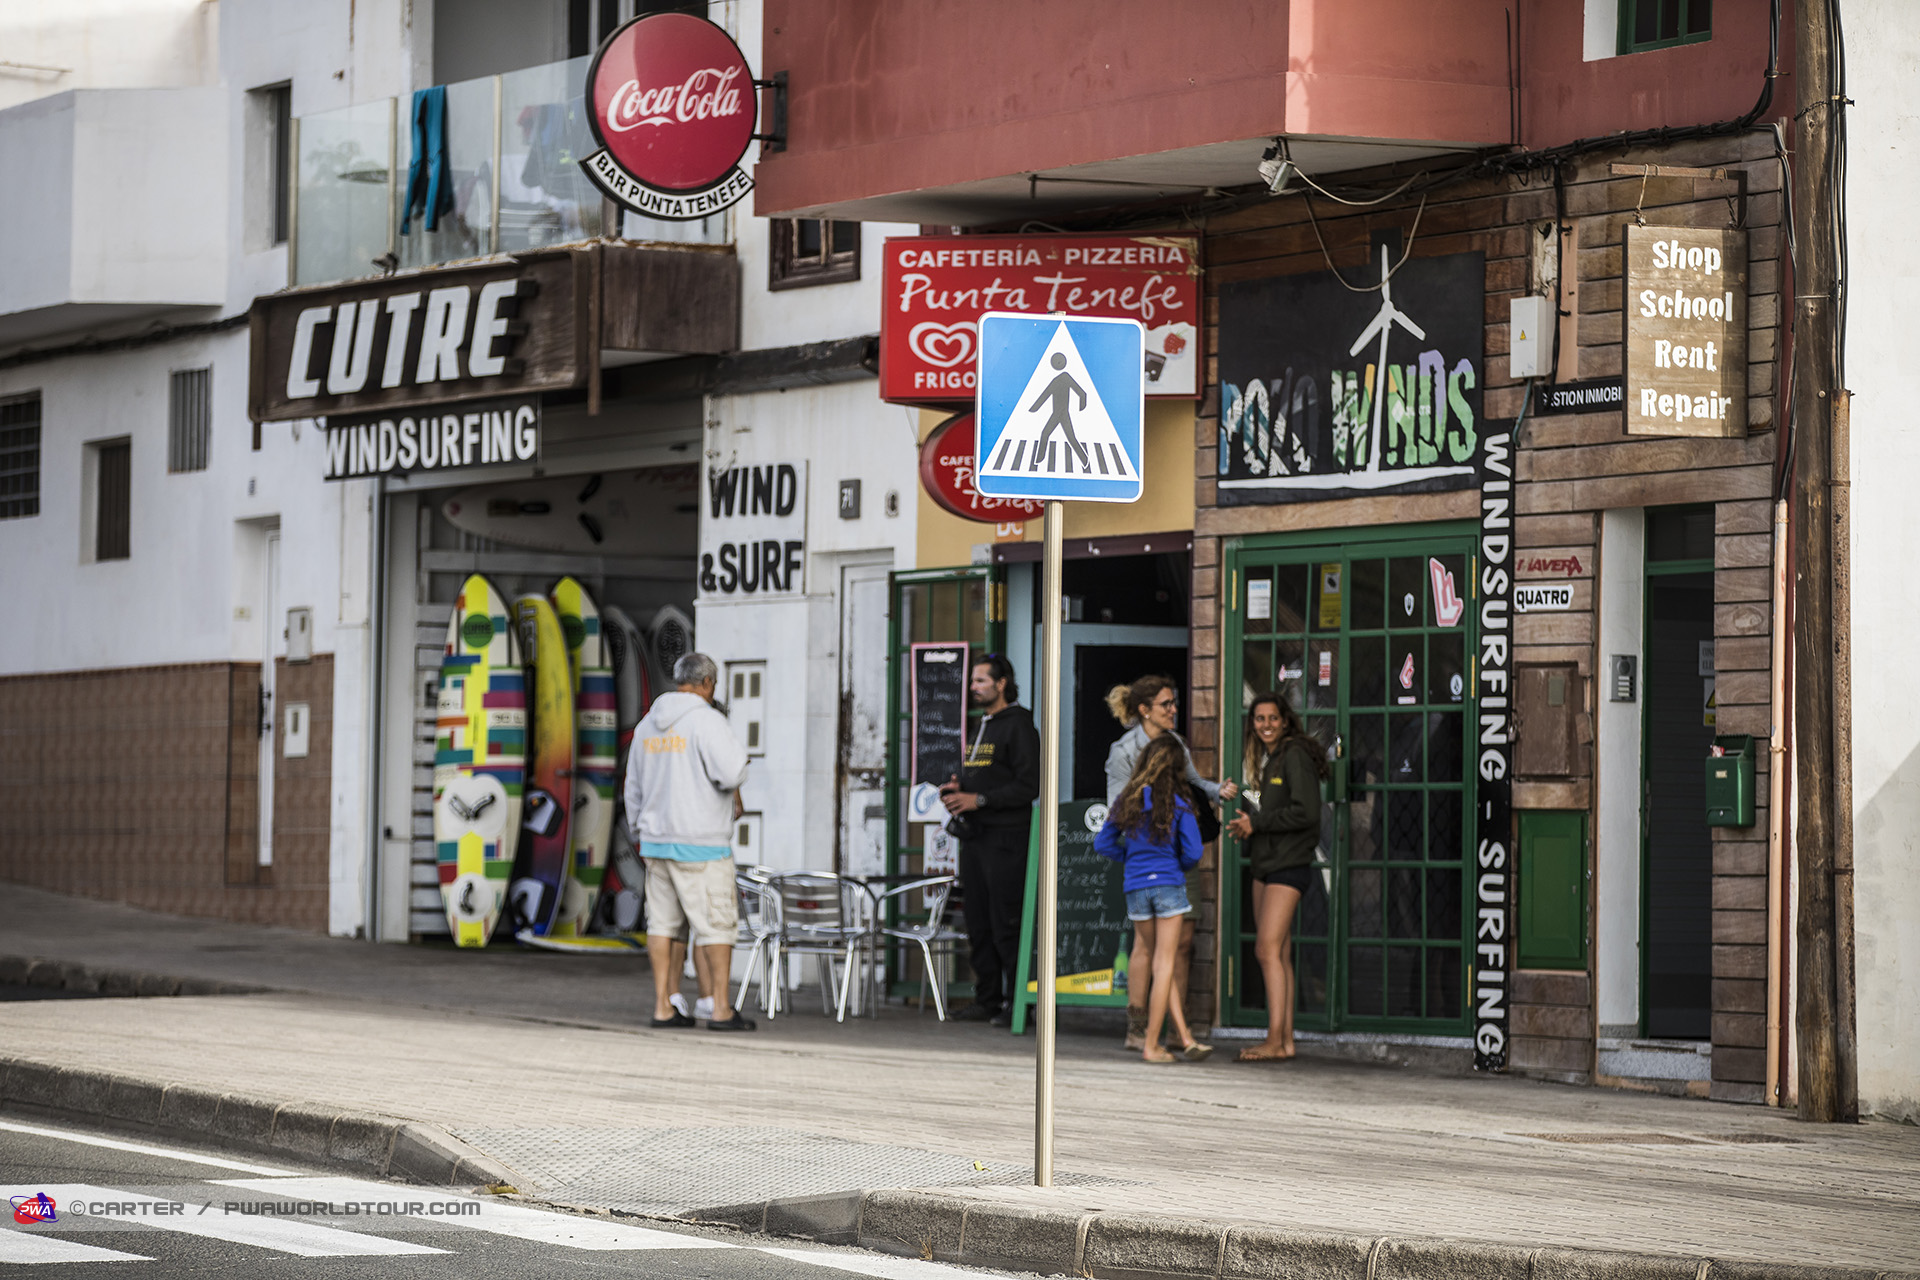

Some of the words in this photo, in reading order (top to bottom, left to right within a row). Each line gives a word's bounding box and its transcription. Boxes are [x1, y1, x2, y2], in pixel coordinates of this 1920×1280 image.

[607, 65, 742, 132] Coca-Cola
[596, 154, 626, 193] BAR
[899, 244, 1042, 267] CAFETERÍA
[1652, 239, 1721, 276] Shop
[899, 273, 1031, 312] Punta
[1033, 271, 1184, 319] Tenefe
[1639, 289, 1733, 322] School
[286, 279, 518, 399] CUTRE
[1654, 339, 1718, 372] Rent
[914, 371, 976, 389] FRIGO
[1640, 388, 1732, 422] Repair
[324, 405, 537, 476] WINDSURFING
[709, 464, 797, 519] WIND
[1479, 432, 1511, 783] WINDSURFING
[1516, 590, 1569, 609] QUATRO
[1477, 838, 1506, 1056] SURFING
